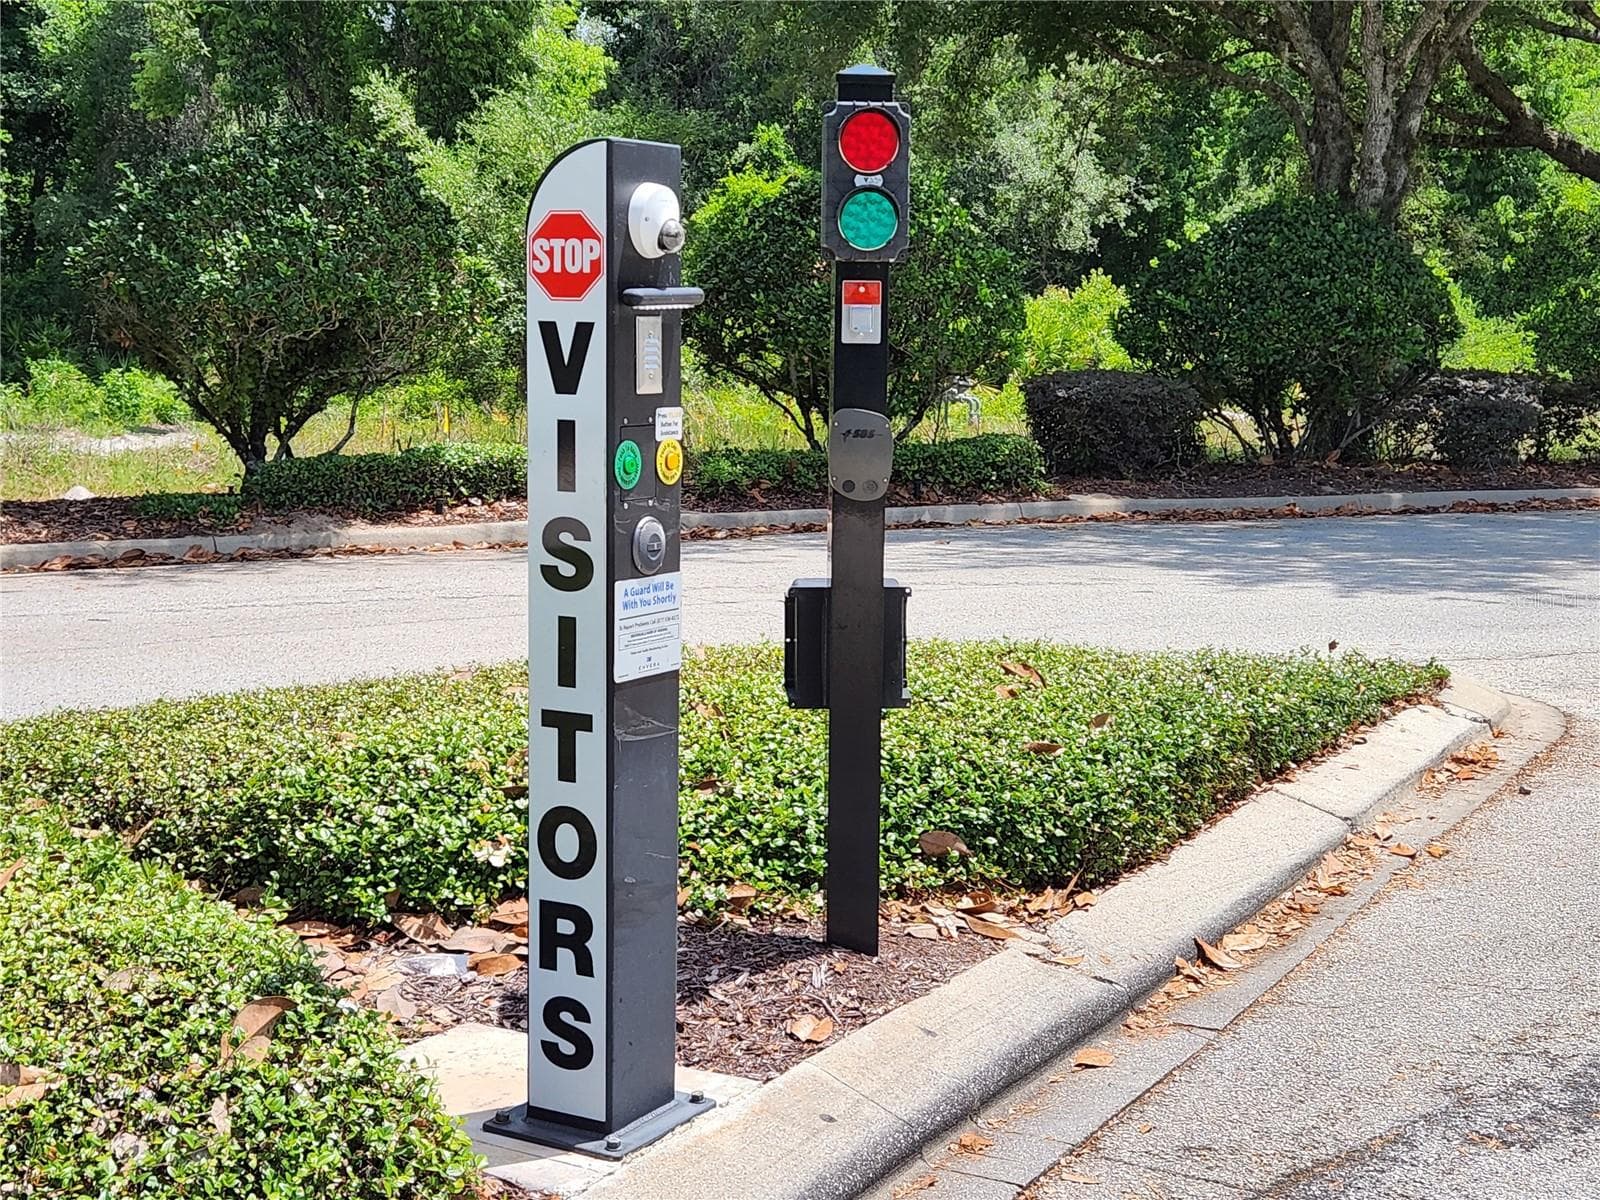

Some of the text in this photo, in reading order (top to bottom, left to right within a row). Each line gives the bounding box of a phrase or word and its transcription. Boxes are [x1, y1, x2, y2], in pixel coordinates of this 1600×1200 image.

[532, 238, 601, 273] STOP
[622, 592, 676, 611] With You Shortly
[623, 580, 674, 597] A Guard Will Be
[537, 320, 598, 1071] VISITORS
